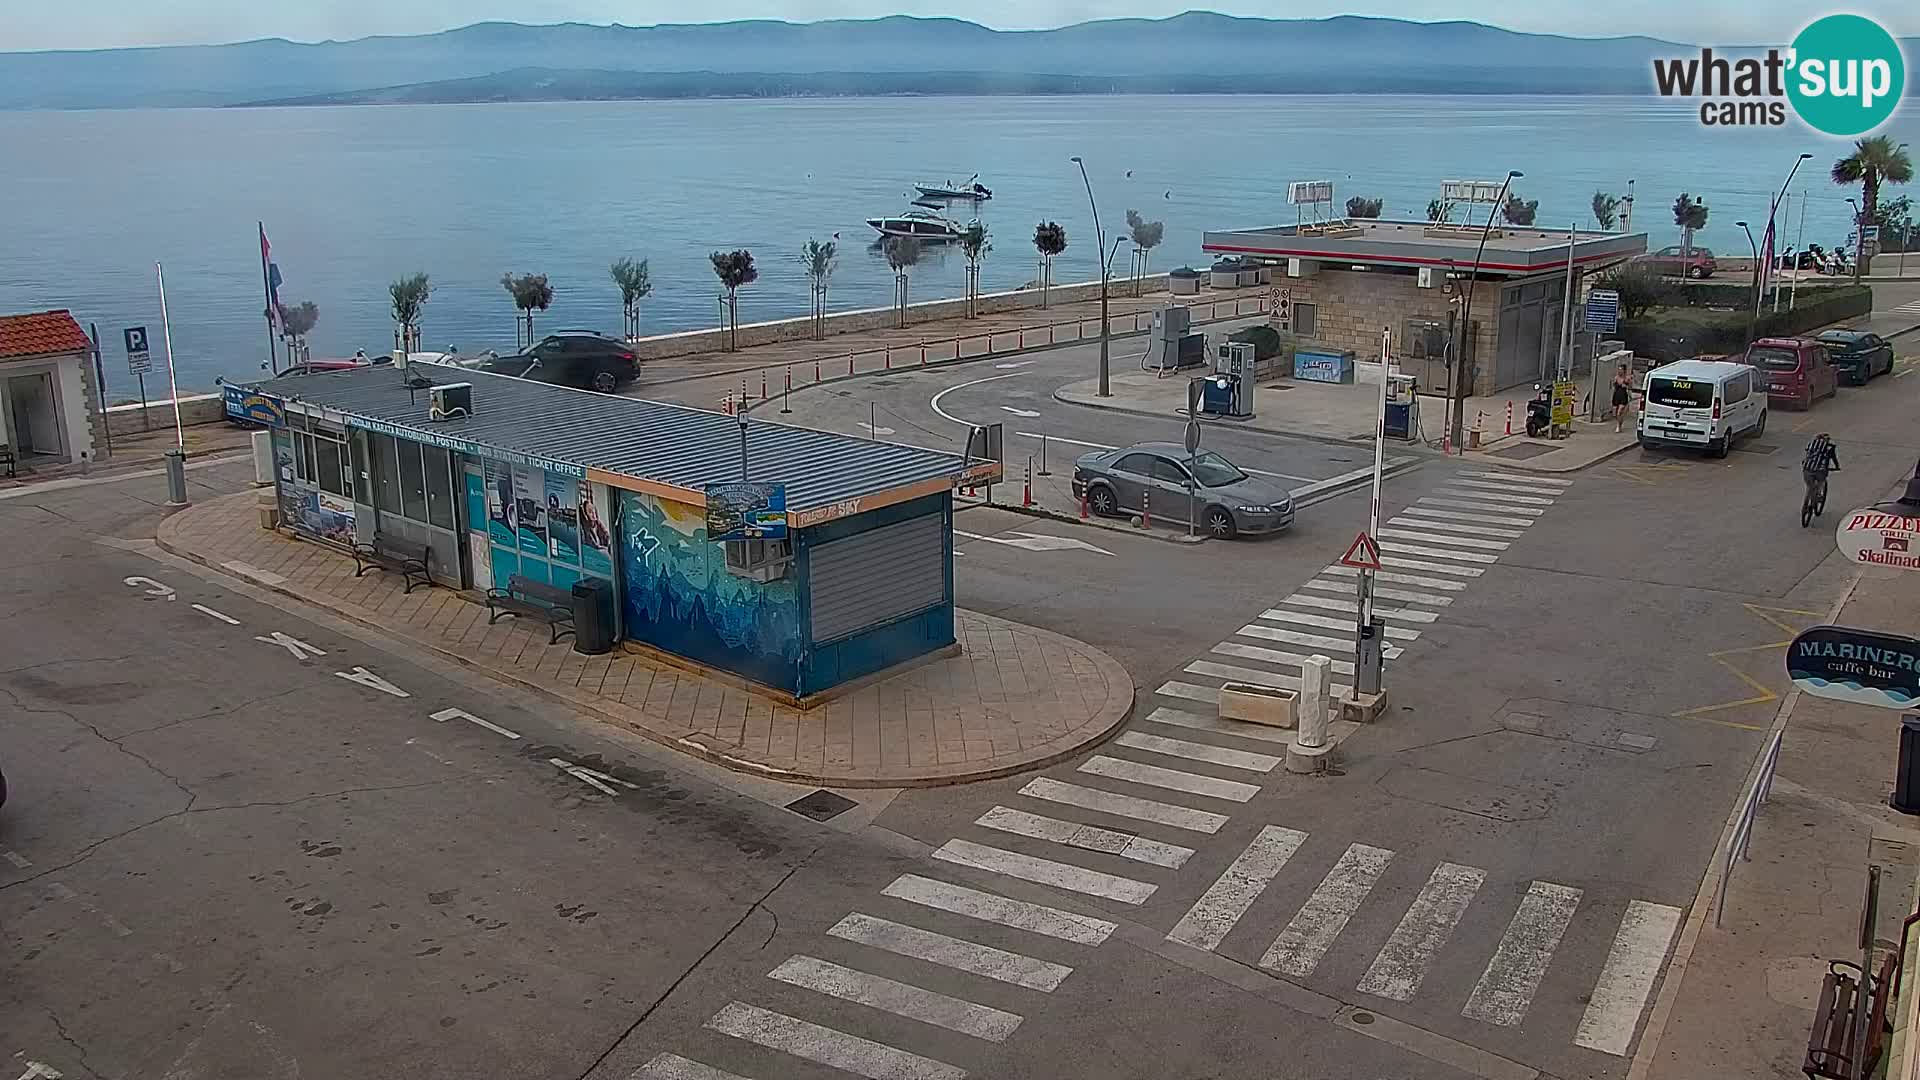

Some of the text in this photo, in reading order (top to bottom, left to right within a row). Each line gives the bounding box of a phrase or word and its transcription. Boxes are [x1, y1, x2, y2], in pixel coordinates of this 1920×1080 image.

[130, 331, 142, 349] P
[1672, 381, 1692, 389] TAXI
[346, 416, 582, 477] PRODAJA KARATA AUTOBUSNA POSTAJA BUS STATION TICKET OFFICE
[1880, 530, 1916, 539] GRILL
[1827, 662, 1896, 679] caffe bar
